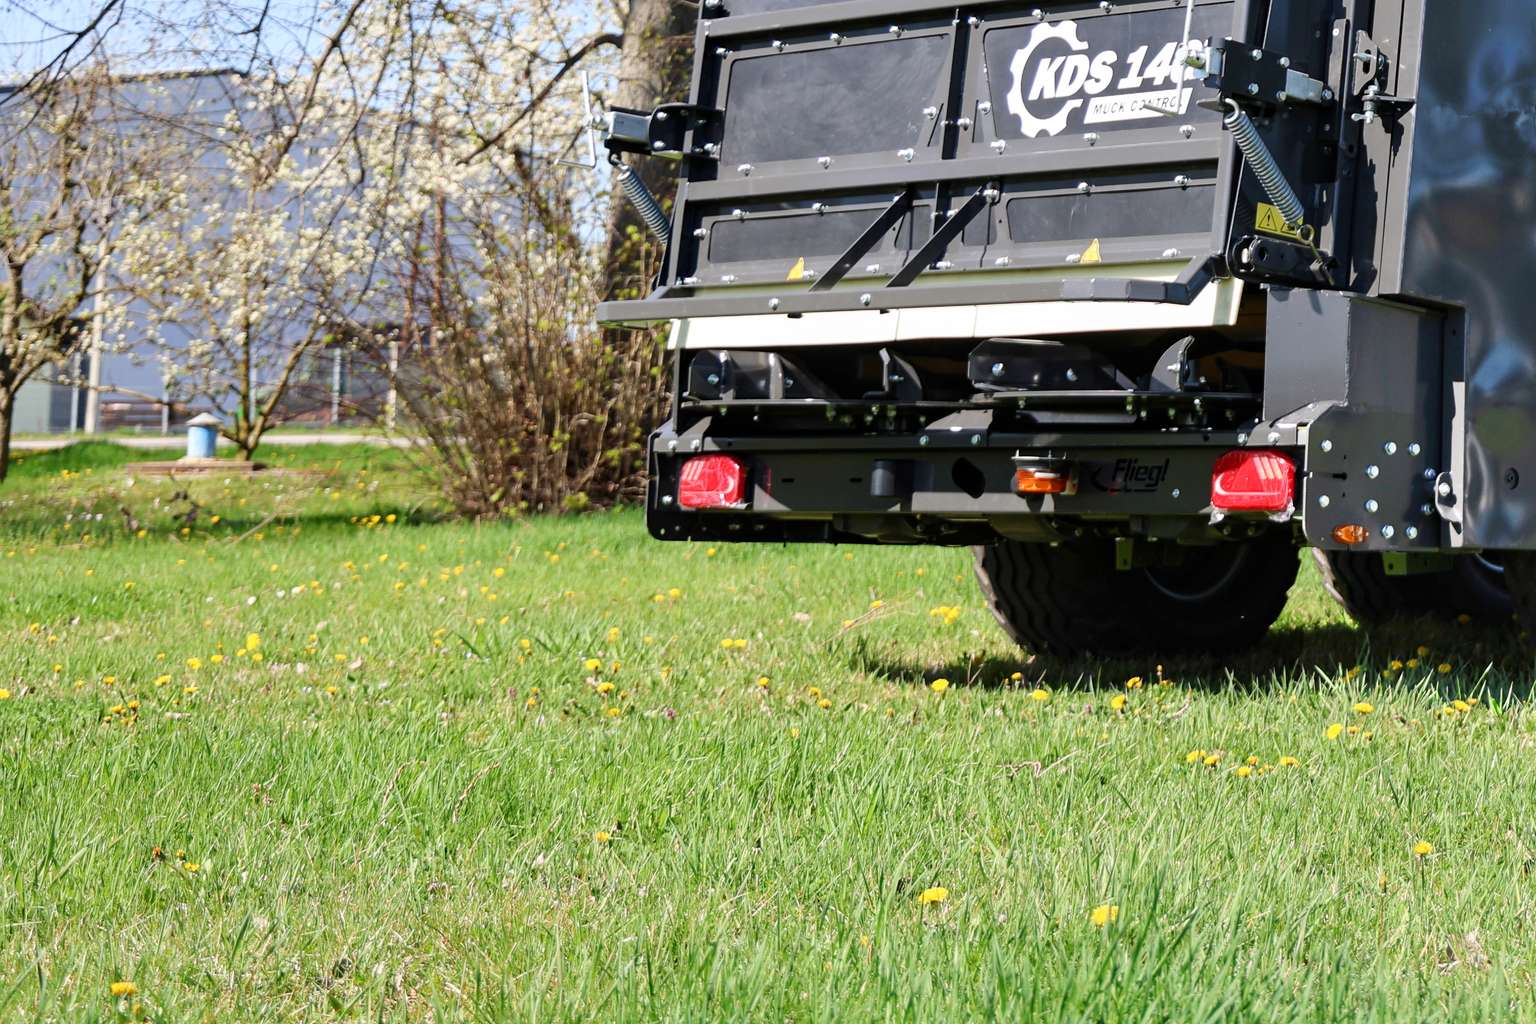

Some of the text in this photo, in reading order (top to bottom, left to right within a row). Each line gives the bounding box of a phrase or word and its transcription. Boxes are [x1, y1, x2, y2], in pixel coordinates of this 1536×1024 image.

[1028, 49, 1118, 101] KDS
[1093, 102, 1125, 115] MUCK
[1112, 458, 1170, 488] Fliegl
